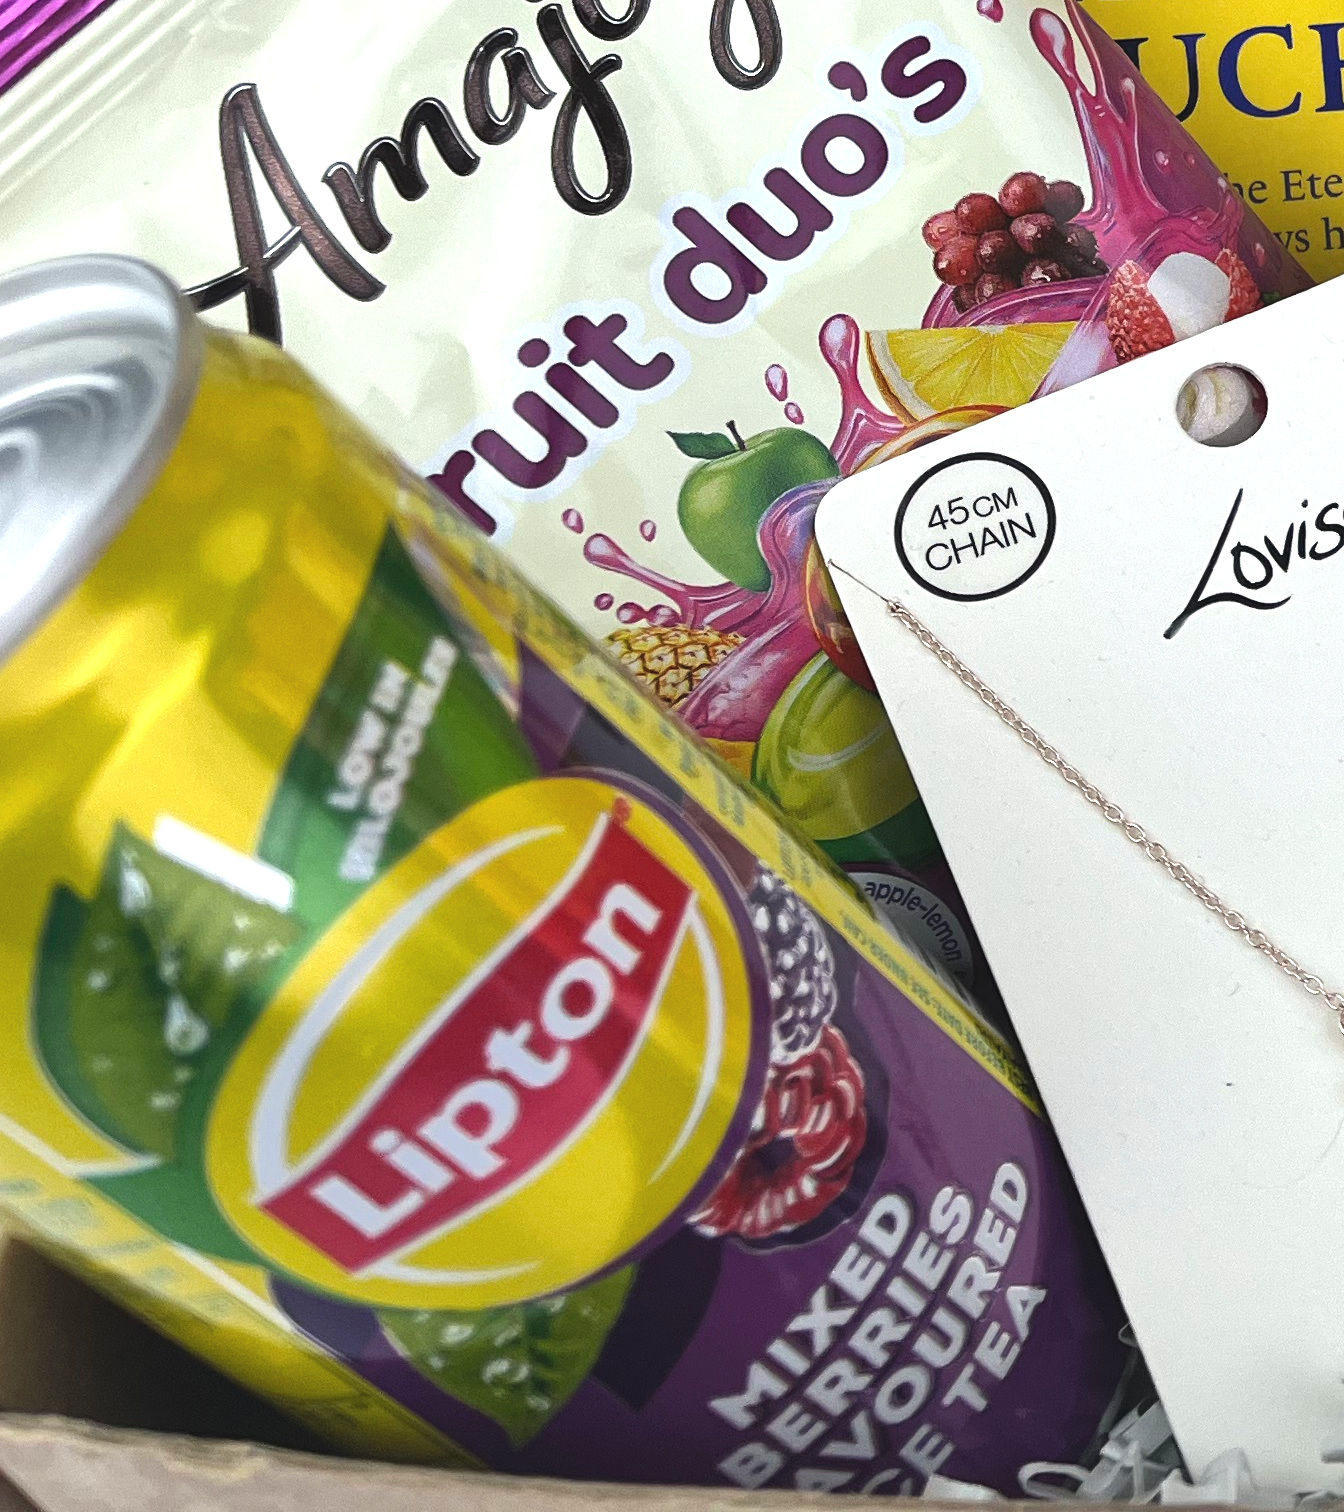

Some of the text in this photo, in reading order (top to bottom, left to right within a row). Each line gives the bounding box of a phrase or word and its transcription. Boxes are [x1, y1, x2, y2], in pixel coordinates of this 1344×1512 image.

[423, 308, 675, 536] ruit
[925, 513, 1036, 572] CHAIN
[865, 881, 962, 962] apple-lemon
[306, 878, 664, 1240] Lipton
[709, 1194, 913, 1430] MIXED
[718, 1186, 974, 1487] BERRIES
[943, 1286, 1047, 1412] TEA
